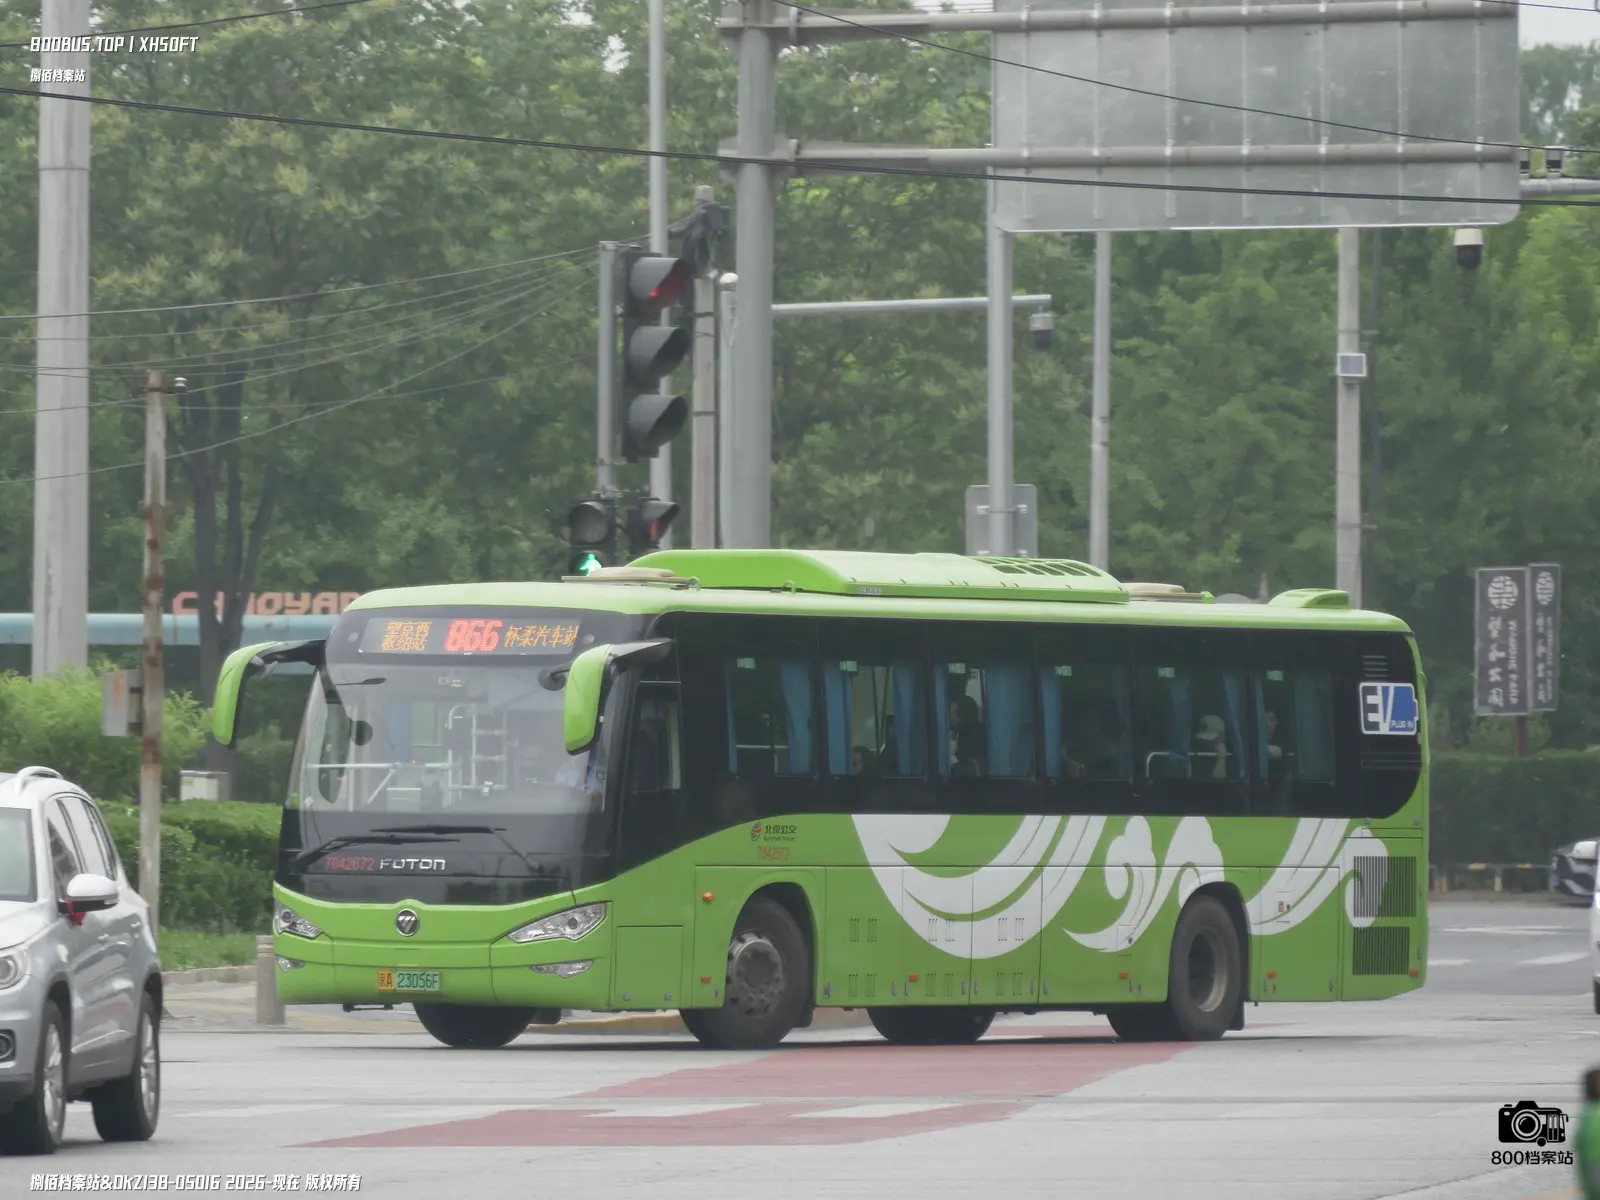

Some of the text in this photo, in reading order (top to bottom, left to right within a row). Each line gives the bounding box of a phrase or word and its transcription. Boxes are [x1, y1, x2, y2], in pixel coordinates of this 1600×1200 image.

[172, 591, 361, 616] COYA
[446, 619, 503, 651] 866
[504, 624, 579, 648] 怀柔汽车站
[1361, 684, 1394, 732] EV
[764, 824, 797, 835] 北京公交
[380, 859, 446, 870] FOTON
